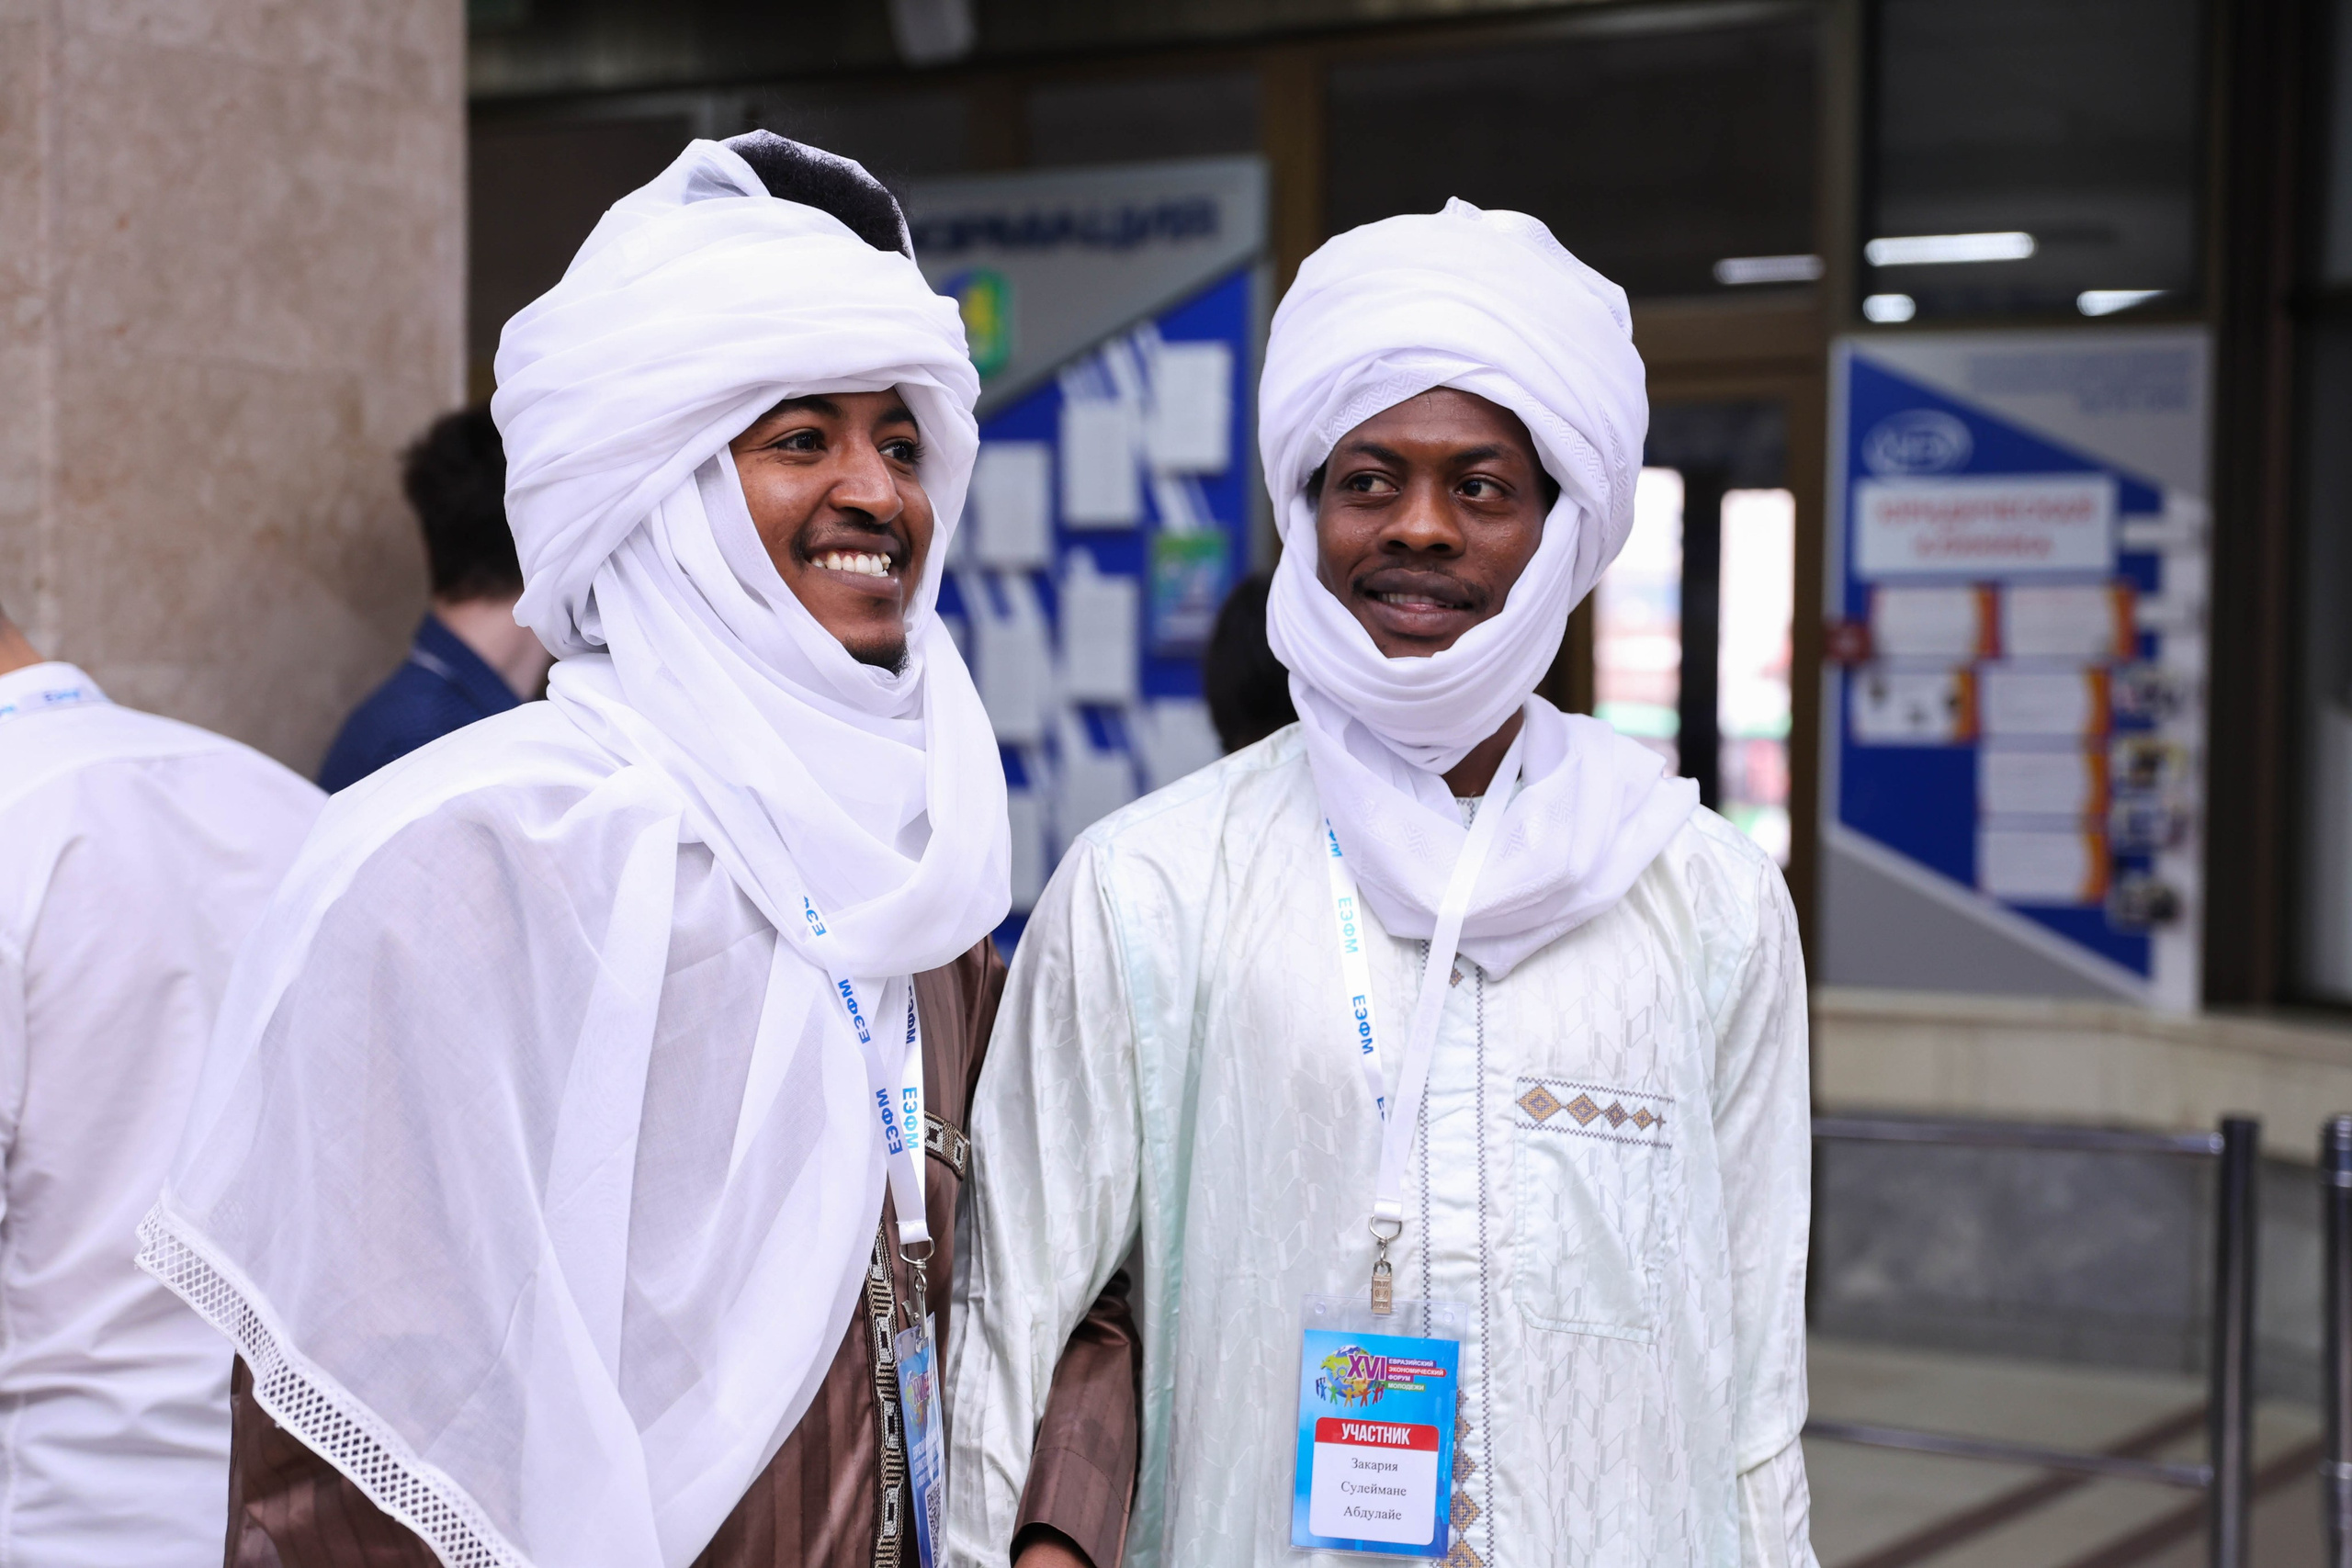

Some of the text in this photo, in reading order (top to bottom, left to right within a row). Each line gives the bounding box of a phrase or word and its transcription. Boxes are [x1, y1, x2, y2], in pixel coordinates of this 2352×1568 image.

[1338, 896, 1359, 953] ЕЭФМ
[837, 978, 871, 1044] ЕЭФМ
[1352, 994, 1374, 1055] ЕЭФМ
[876, 1088, 903, 1156] ЕЭФМ
[902, 1087, 919, 1149] ЕЭФМ
[1347, 1354, 1385, 1381] XVI
[1388, 1359, 1434, 1367] ЕВРАЗИЙСКИЙ
[1388, 1367, 1444, 1376] ЭКОНОМИЧЕСКИЙ
[1387, 1382, 1424, 1392] МОЛОДЕЖИ
[1341, 1423, 1410, 1445] УЧАСТНИК
[1351, 1457, 1398, 1472] Закария
[1340, 1481, 1407, 1497] Сулеймане
[1343, 1506, 1402, 1521] Абдулайе
